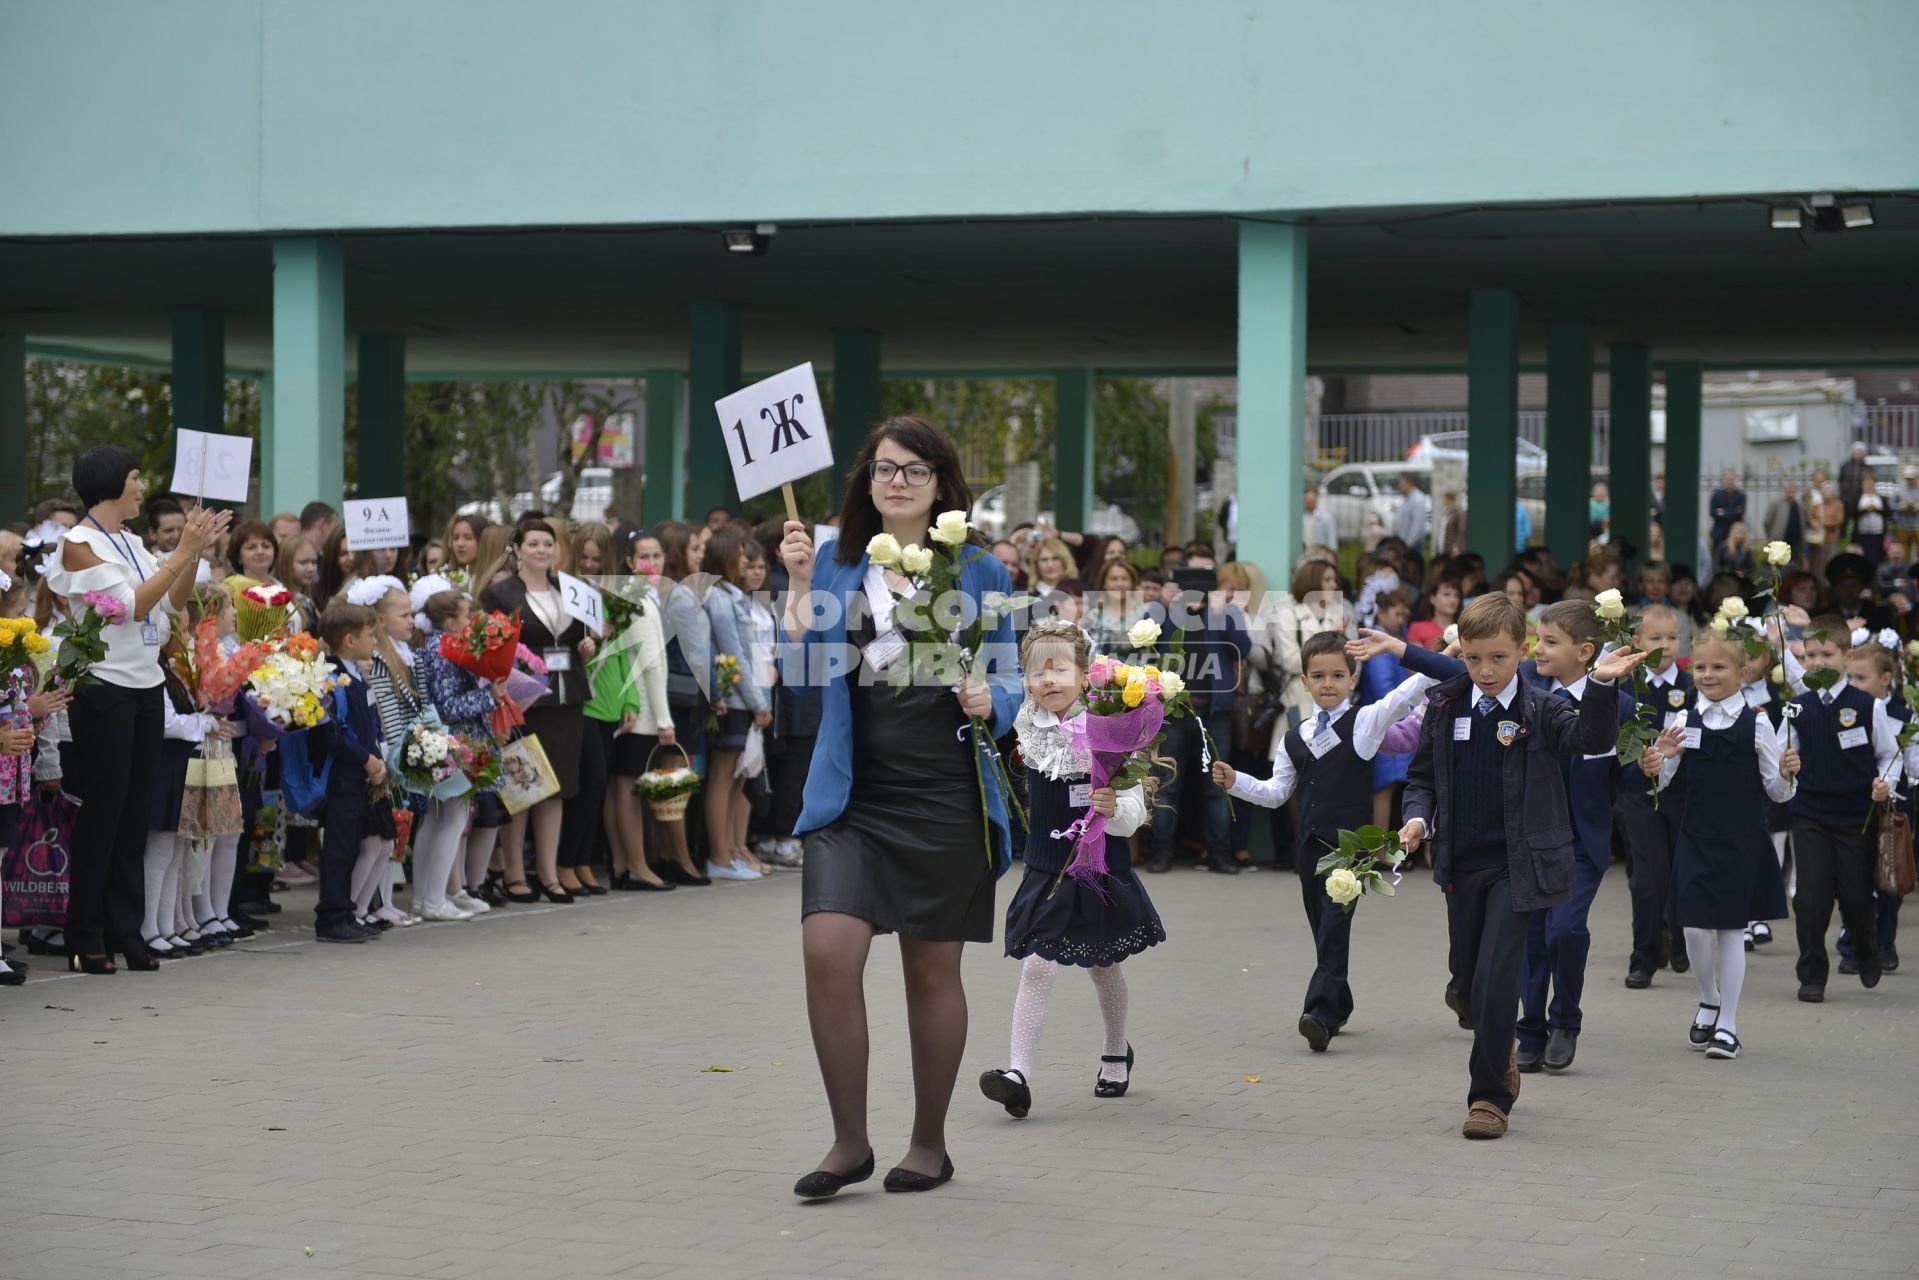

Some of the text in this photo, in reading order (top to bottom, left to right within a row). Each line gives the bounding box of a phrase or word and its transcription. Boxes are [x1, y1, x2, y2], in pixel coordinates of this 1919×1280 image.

[732, 393, 813, 467] 1 Ж
[362, 506, 390, 521] 9 А
[568, 586, 598, 623] 2 Д
